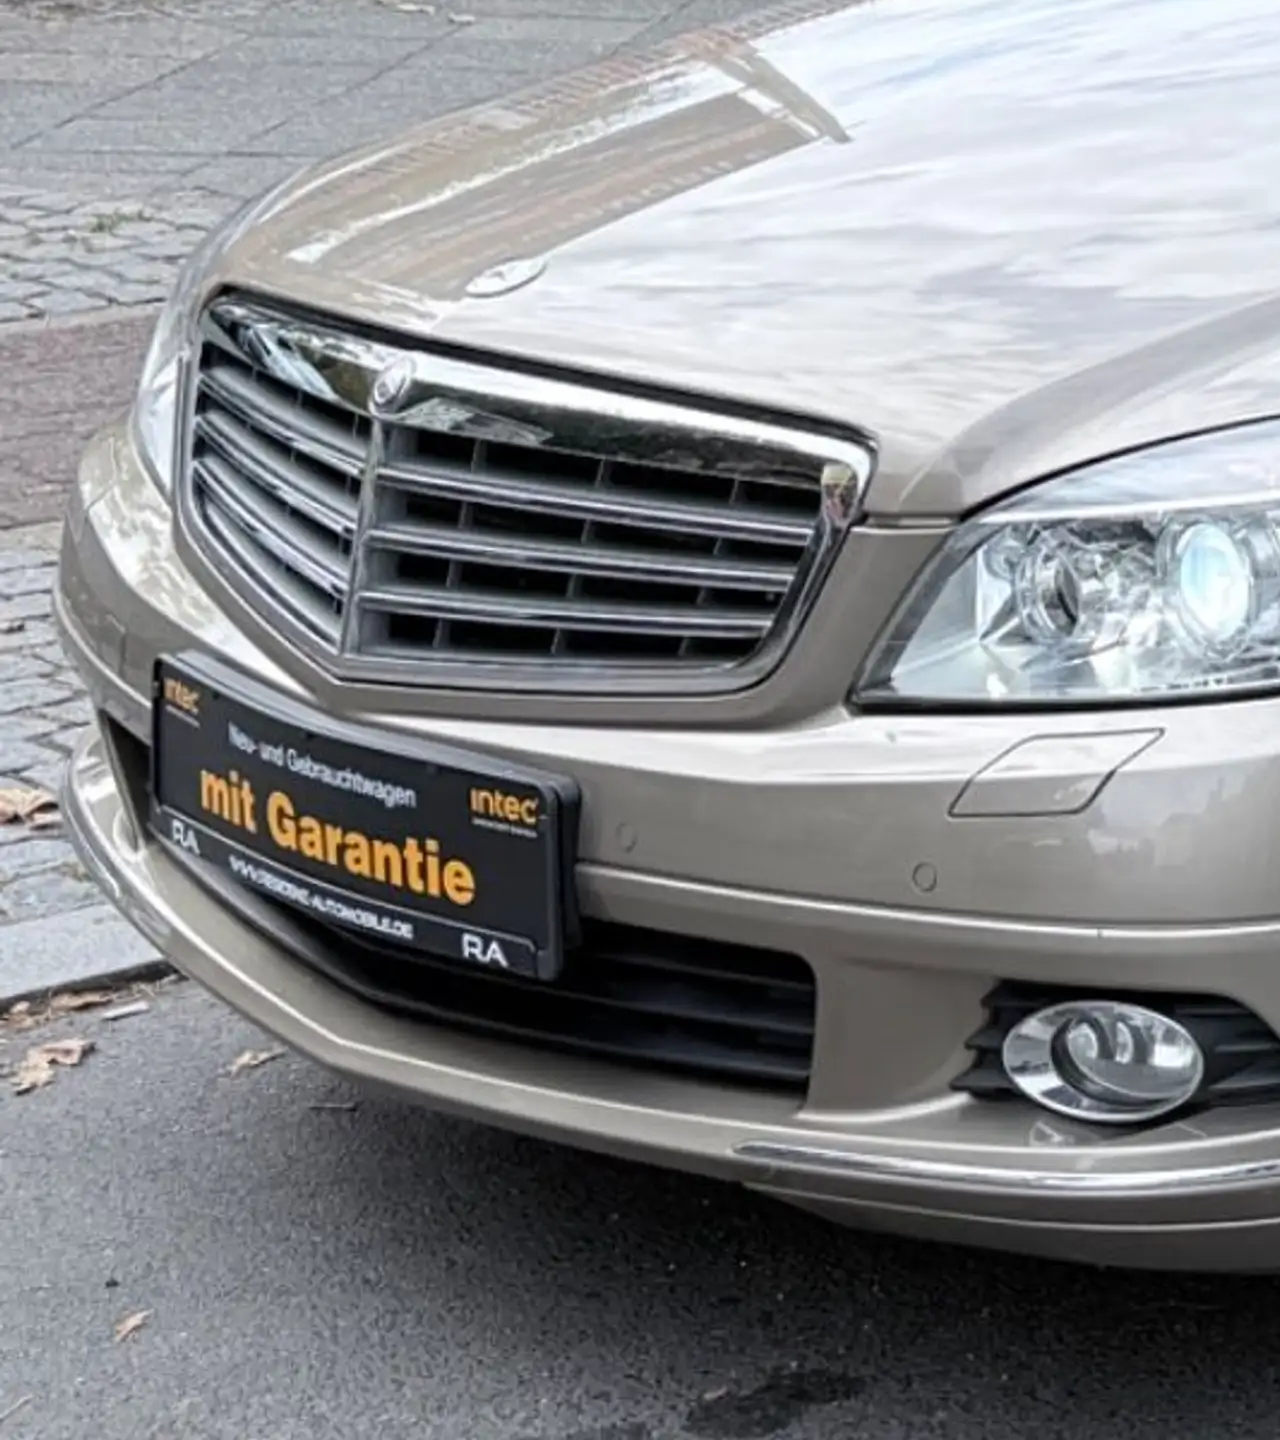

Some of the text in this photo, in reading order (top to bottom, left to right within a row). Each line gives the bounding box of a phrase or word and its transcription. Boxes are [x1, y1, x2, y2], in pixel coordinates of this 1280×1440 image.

[286, 747, 417, 809] Gebrauchtwagen
[172, 818, 201, 856] RA
[201, 769, 475, 906] mit Garantie
[462, 932, 509, 968] RA
